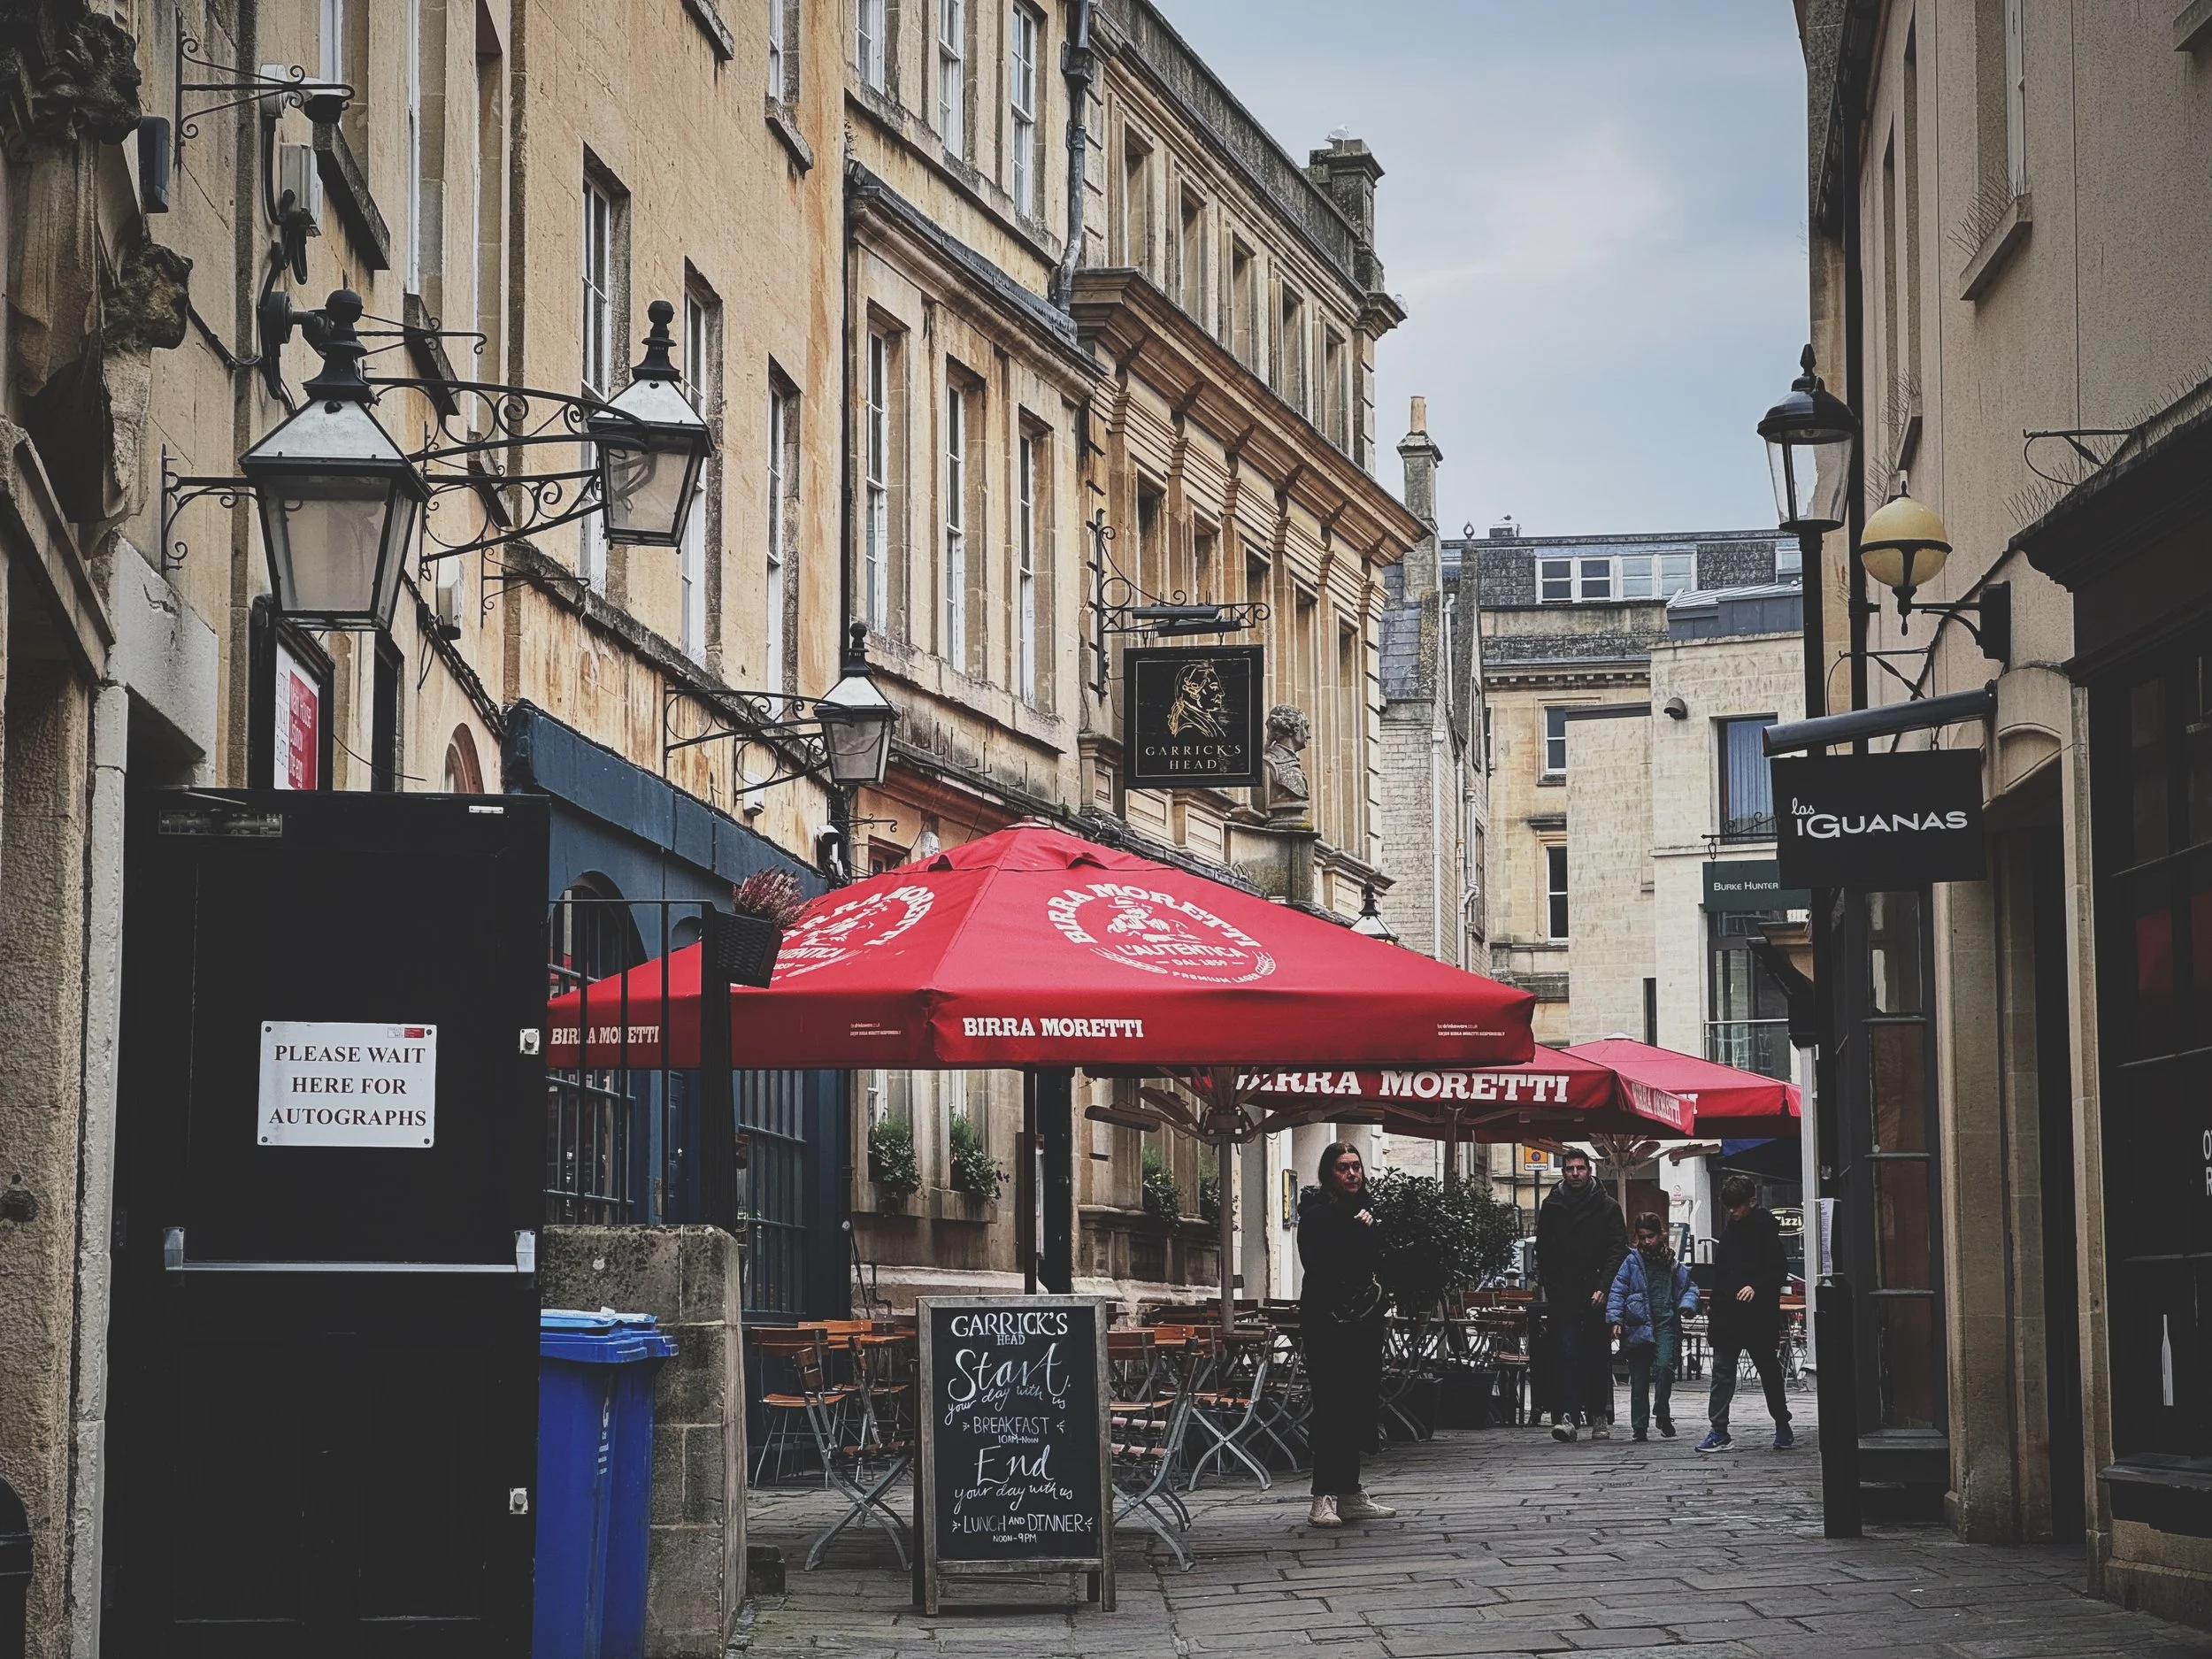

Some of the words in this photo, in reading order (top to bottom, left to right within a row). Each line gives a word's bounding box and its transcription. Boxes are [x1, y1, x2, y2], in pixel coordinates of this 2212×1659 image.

[1145, 745, 1241, 757] GARRICK'S
[1170, 759, 1217, 770] HEAD
[1791, 797, 1816, 816] las
[1713, 882, 1742, 891] BURKE
[1744, 881, 1779, 890] HUNTER
[1048, 889, 1099, 944] BIRRA
[1086, 883, 1263, 948] MORETTI
[1115, 943, 1249, 958] L'AUTENTICA
[962, 1018, 1035, 1037] BIRRA
[1040, 1018, 1144, 1038] MORETTI
[274, 1045, 361, 1063] PLEASE
[367, 1047, 426, 1064] WAIT
[291, 1077, 354, 1094] HERE
[361, 1078, 407, 1094] FOR
[1379, 1070, 1570, 1103] MORETTI
[268, 1108, 427, 1126] AUTOGRAPHS
[950, 1312, 1069, 1337] GARRICK'S
[996, 1334, 1025, 1346] HEAD
[948, 1342, 1070, 1402] Start
[944, 1400, 977, 1425] your
[981, 1387, 1010, 1412] day
[1017, 1384, 1044, 1401] with
[1052, 1396, 1066, 1409] us
[973, 1416, 1050, 1436] BREAKFAST
[973, 1444, 1055, 1486] End
[954, 1486, 994, 1515] your
[995, 1483, 1026, 1511] day
[1029, 1481, 1058, 1500] with
[1059, 1487, 1073, 1501] us
[964, 1515, 1007, 1533] LUNCH
[1008, 1517, 1025, 1525] AND
[1027, 1513, 1085, 1532] DINNER
